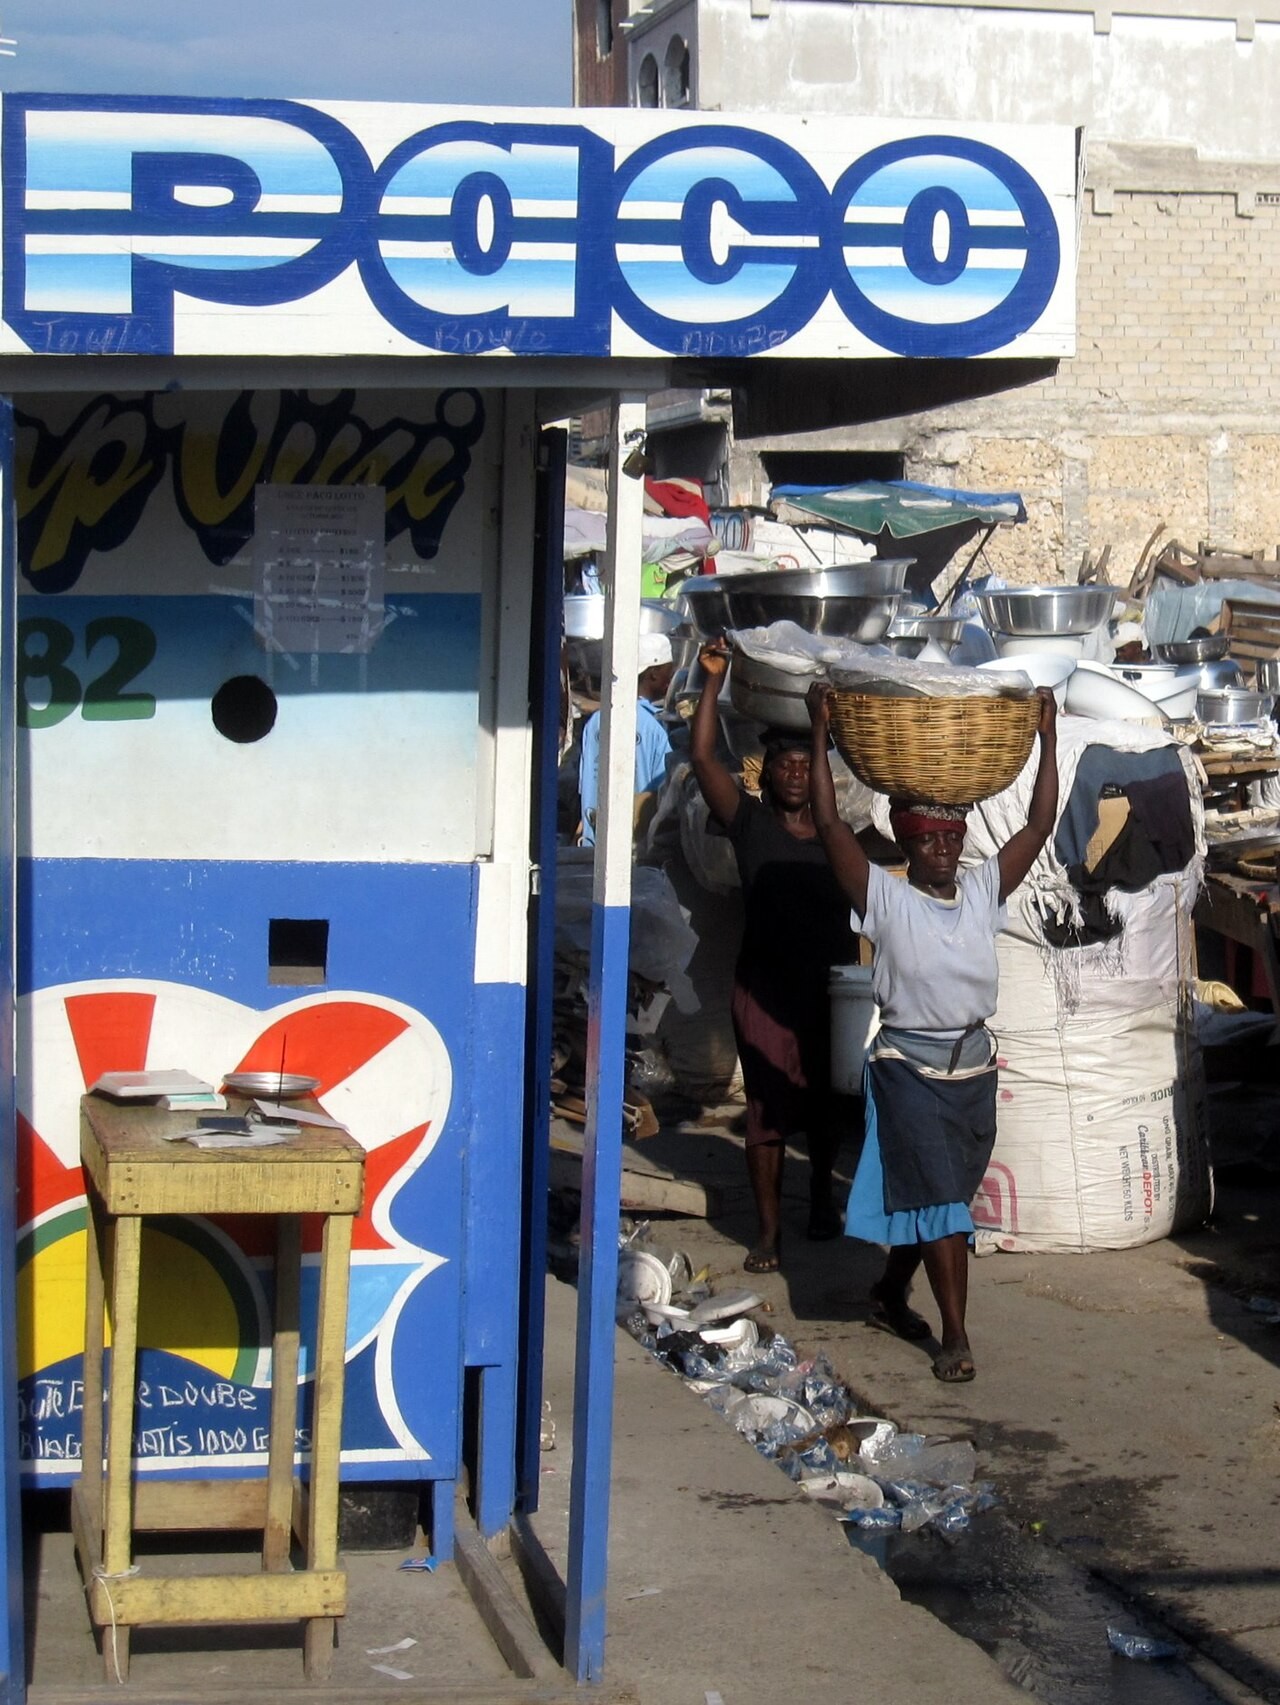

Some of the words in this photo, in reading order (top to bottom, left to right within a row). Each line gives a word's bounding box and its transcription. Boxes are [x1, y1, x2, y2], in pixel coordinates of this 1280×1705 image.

[1118, 1145, 1130, 1161] NET
[1137, 1124, 1150, 1170] Caribbean
[1142, 1171, 1153, 1217] DEPOT
